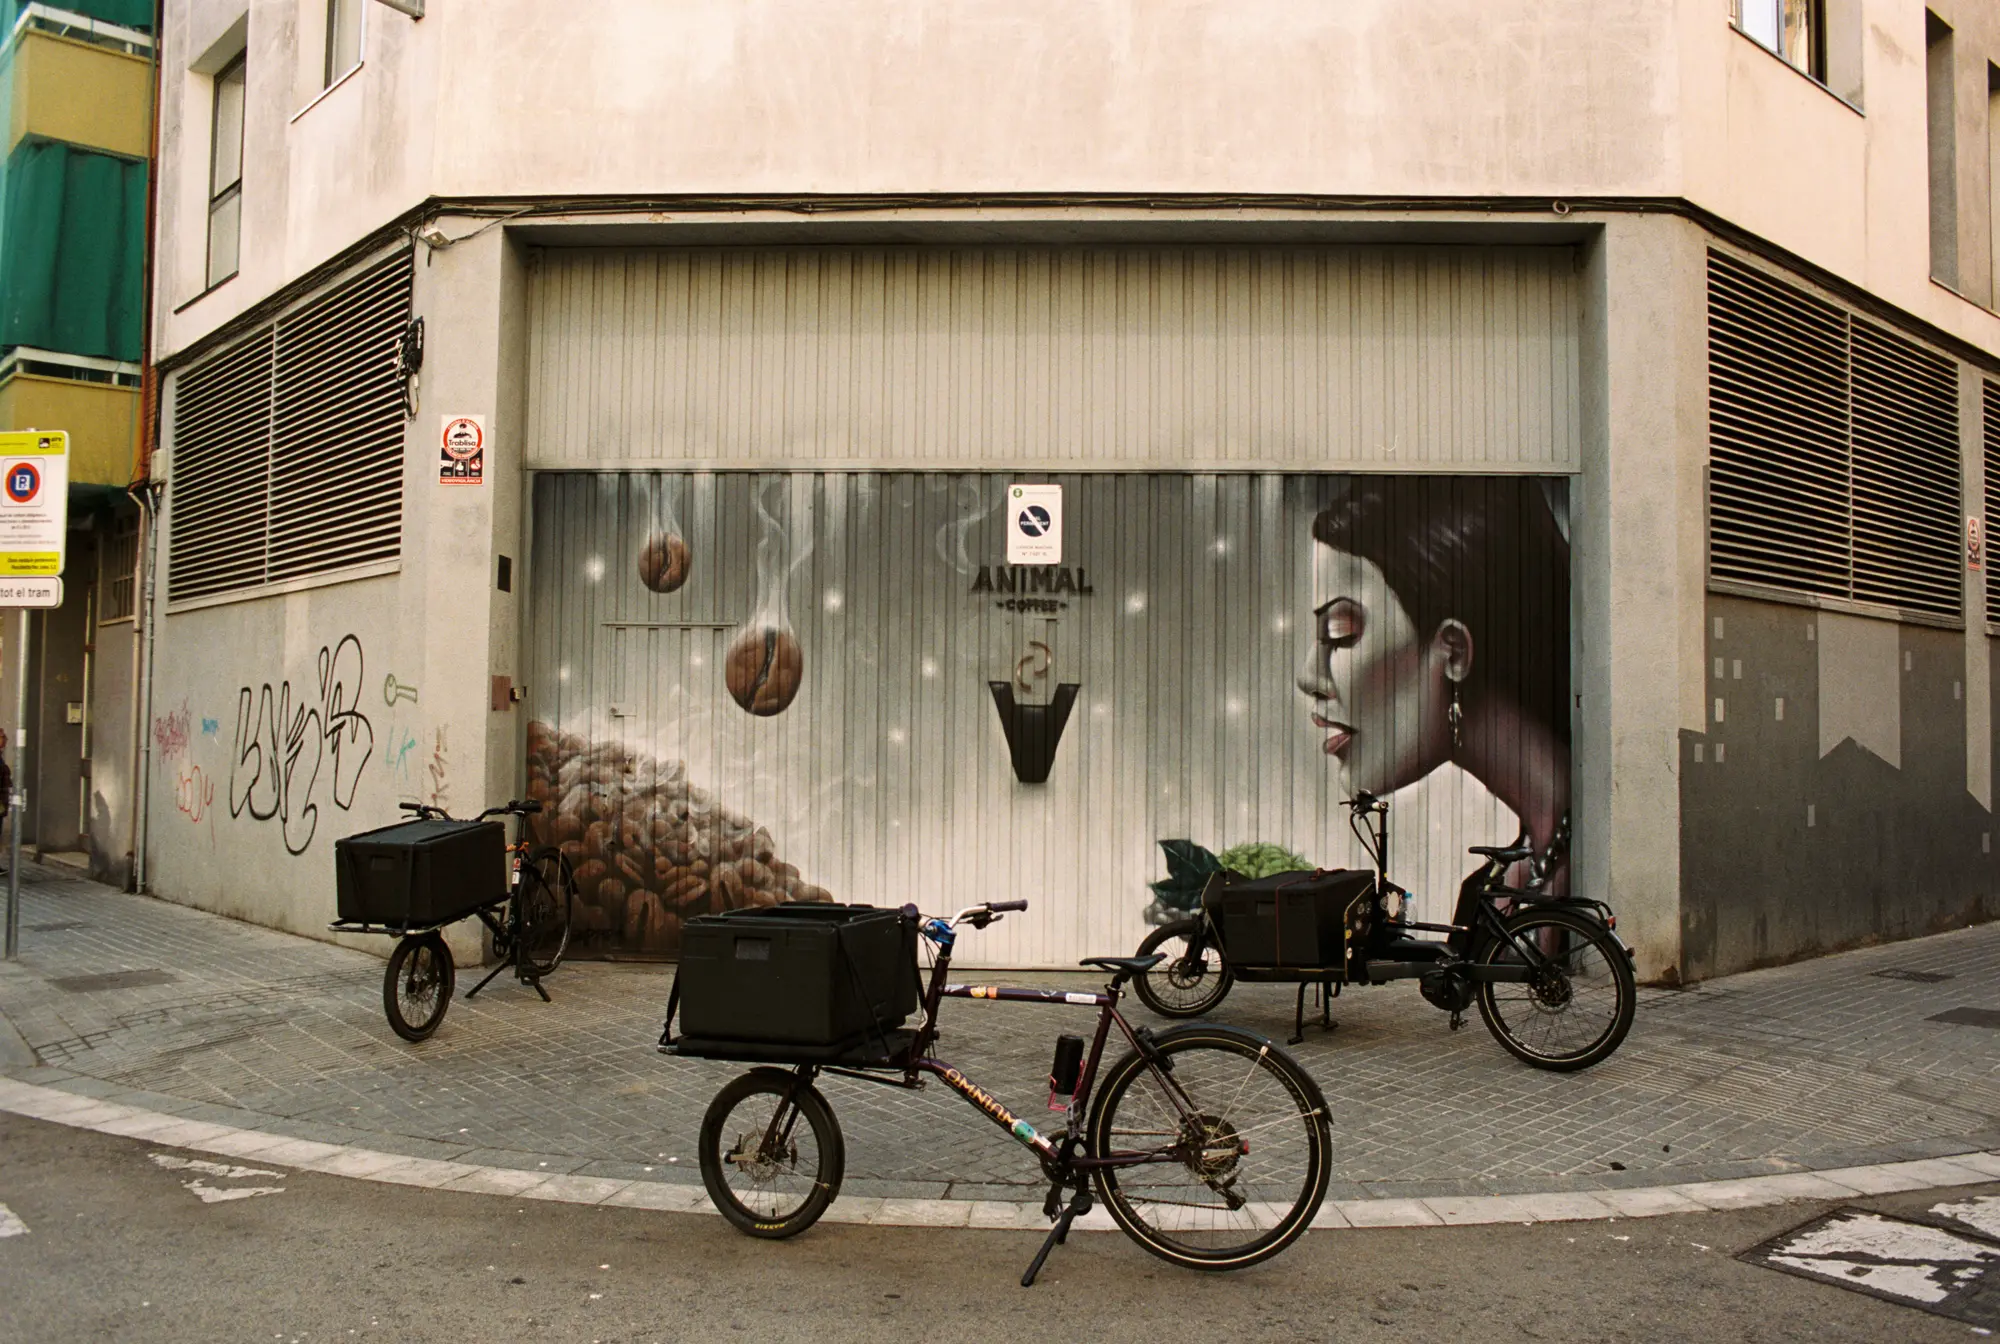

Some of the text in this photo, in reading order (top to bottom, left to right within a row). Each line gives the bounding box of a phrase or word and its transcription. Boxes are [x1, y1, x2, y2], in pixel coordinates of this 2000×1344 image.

[971, 566, 1093, 595] ANIMAL
[16, 587, 25, 598] el
[28, 587, 50, 598] tram
[1006, 599, 1058, 612] COFFEE
